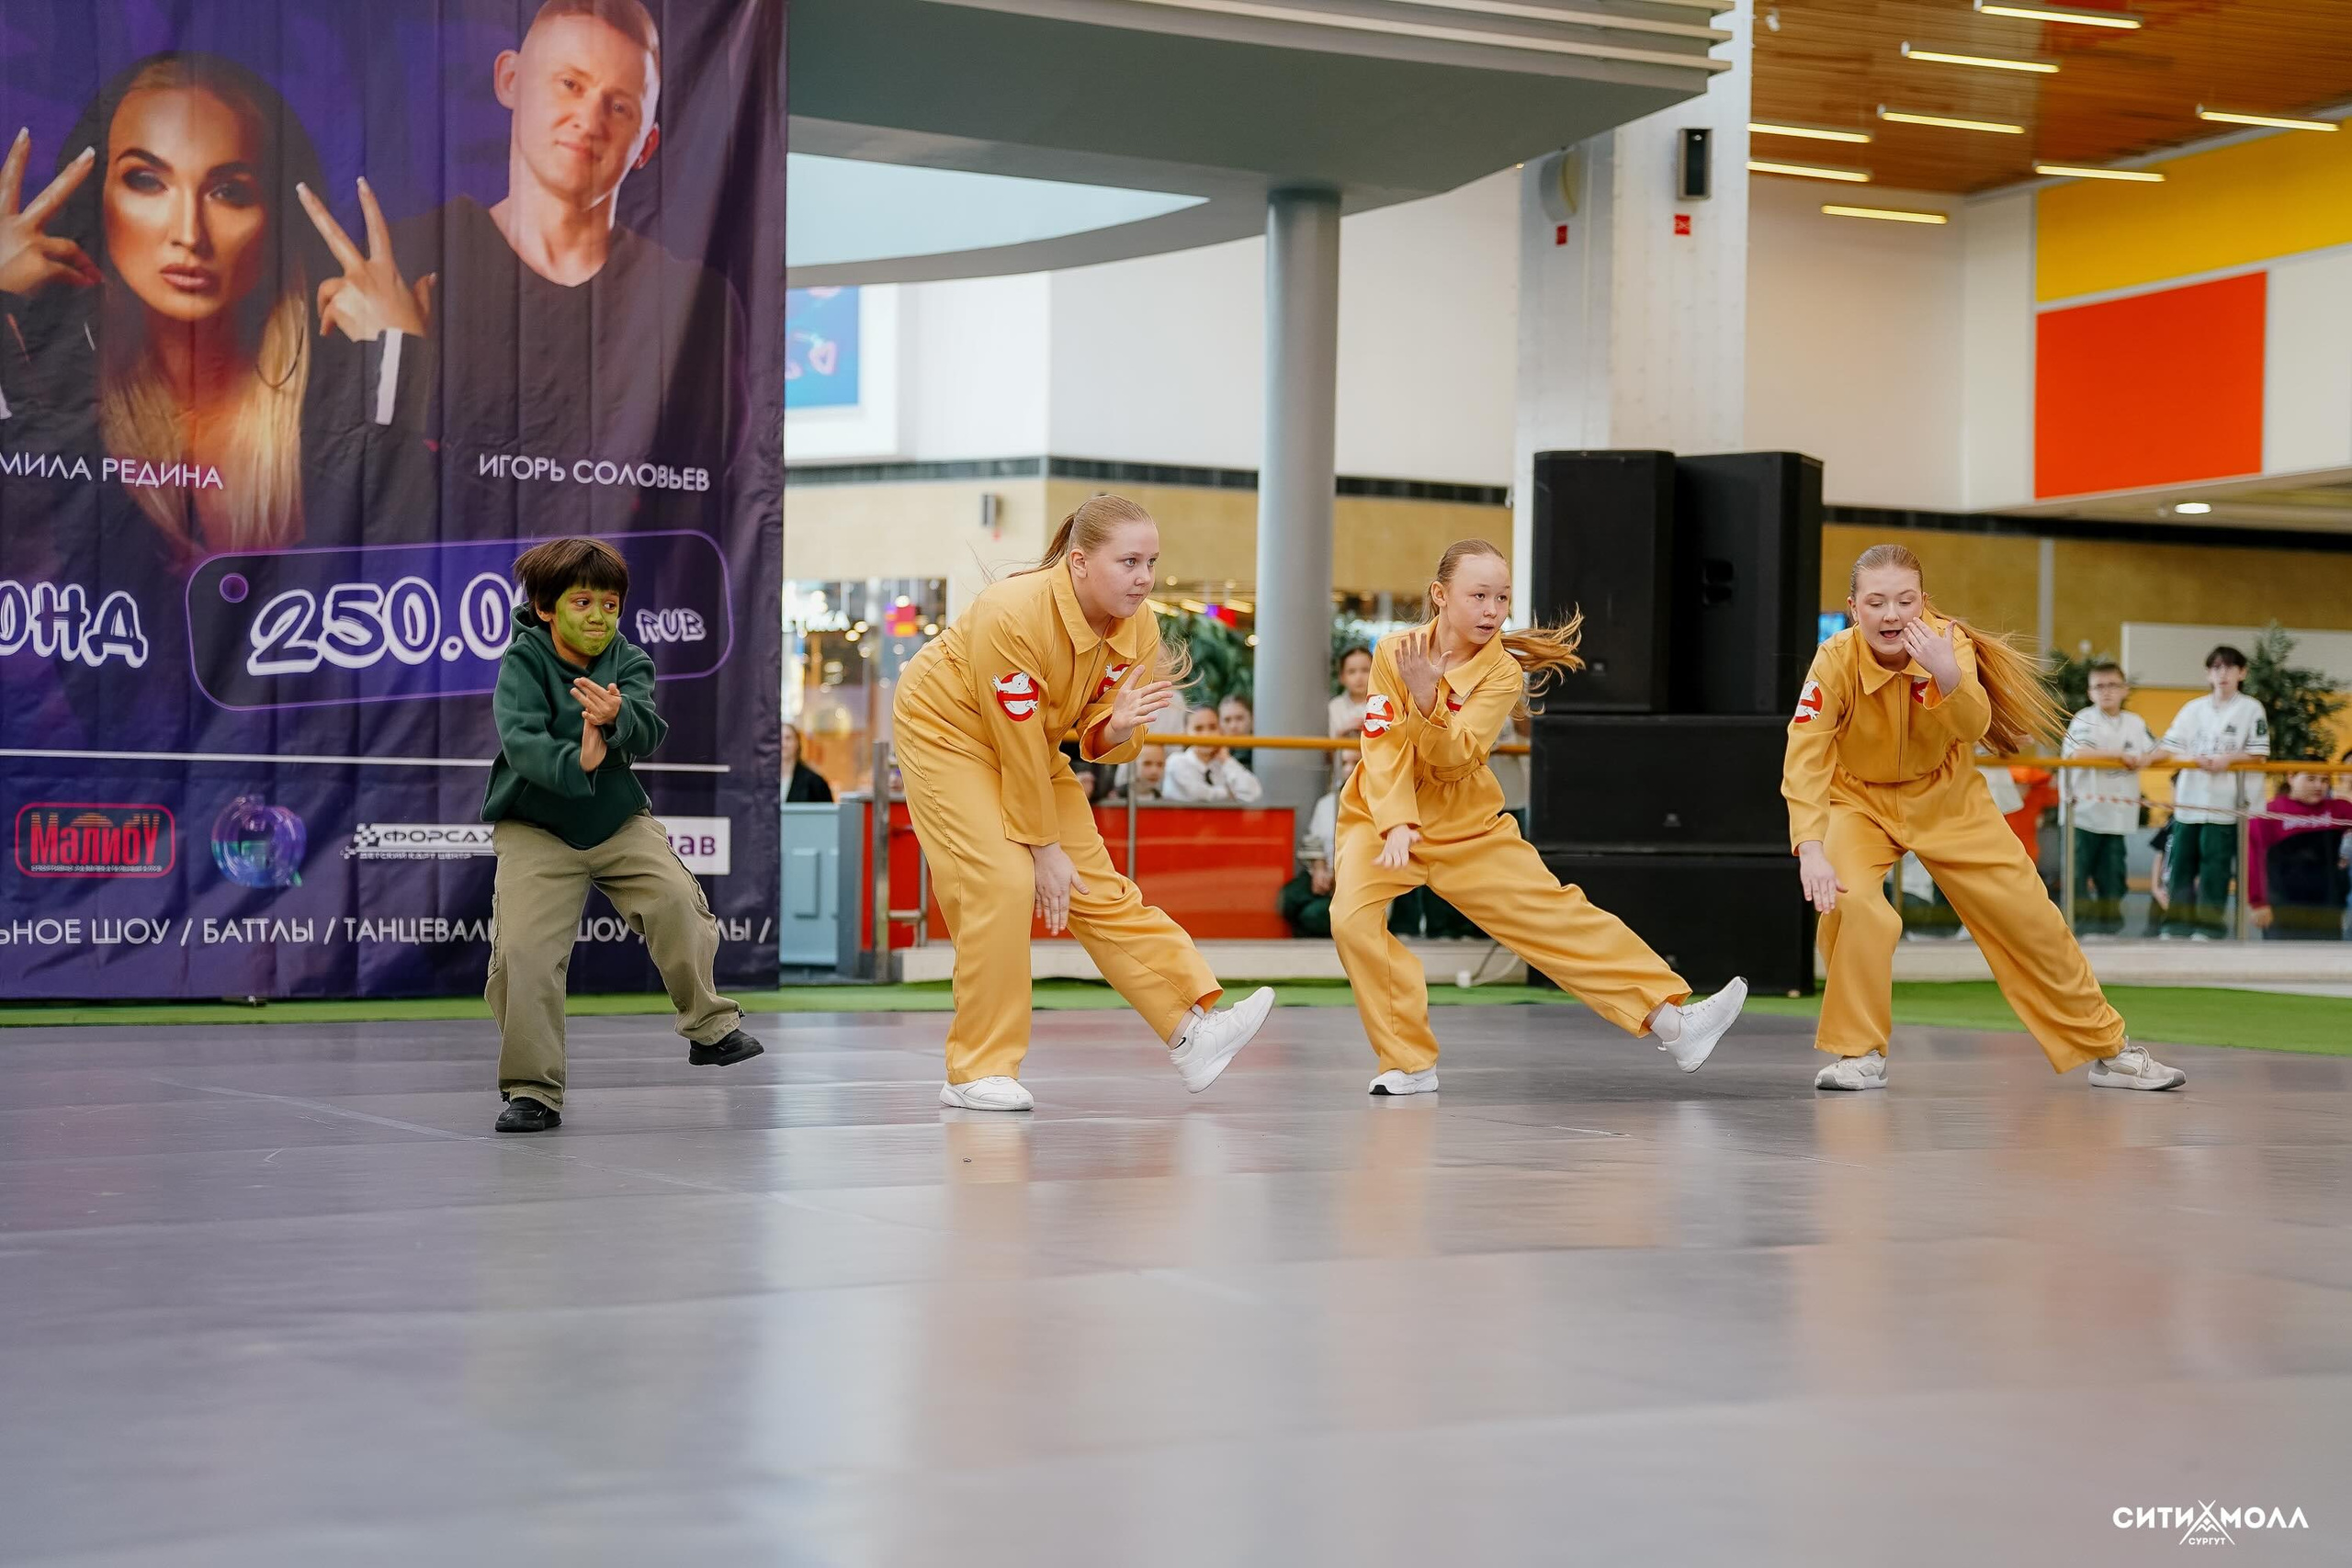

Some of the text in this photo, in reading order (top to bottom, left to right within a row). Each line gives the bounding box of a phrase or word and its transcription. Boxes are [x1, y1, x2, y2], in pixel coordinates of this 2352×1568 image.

[103, 457, 223, 490] РЕДИНА
[479, 453, 710, 491] ИГОРЬ СОЛОВЬЕВ
[246, 571, 707, 676] 250.0 RUB
[92, 918, 171, 945] ШОУ
[203, 918, 314, 943] БАТТЛЫ
